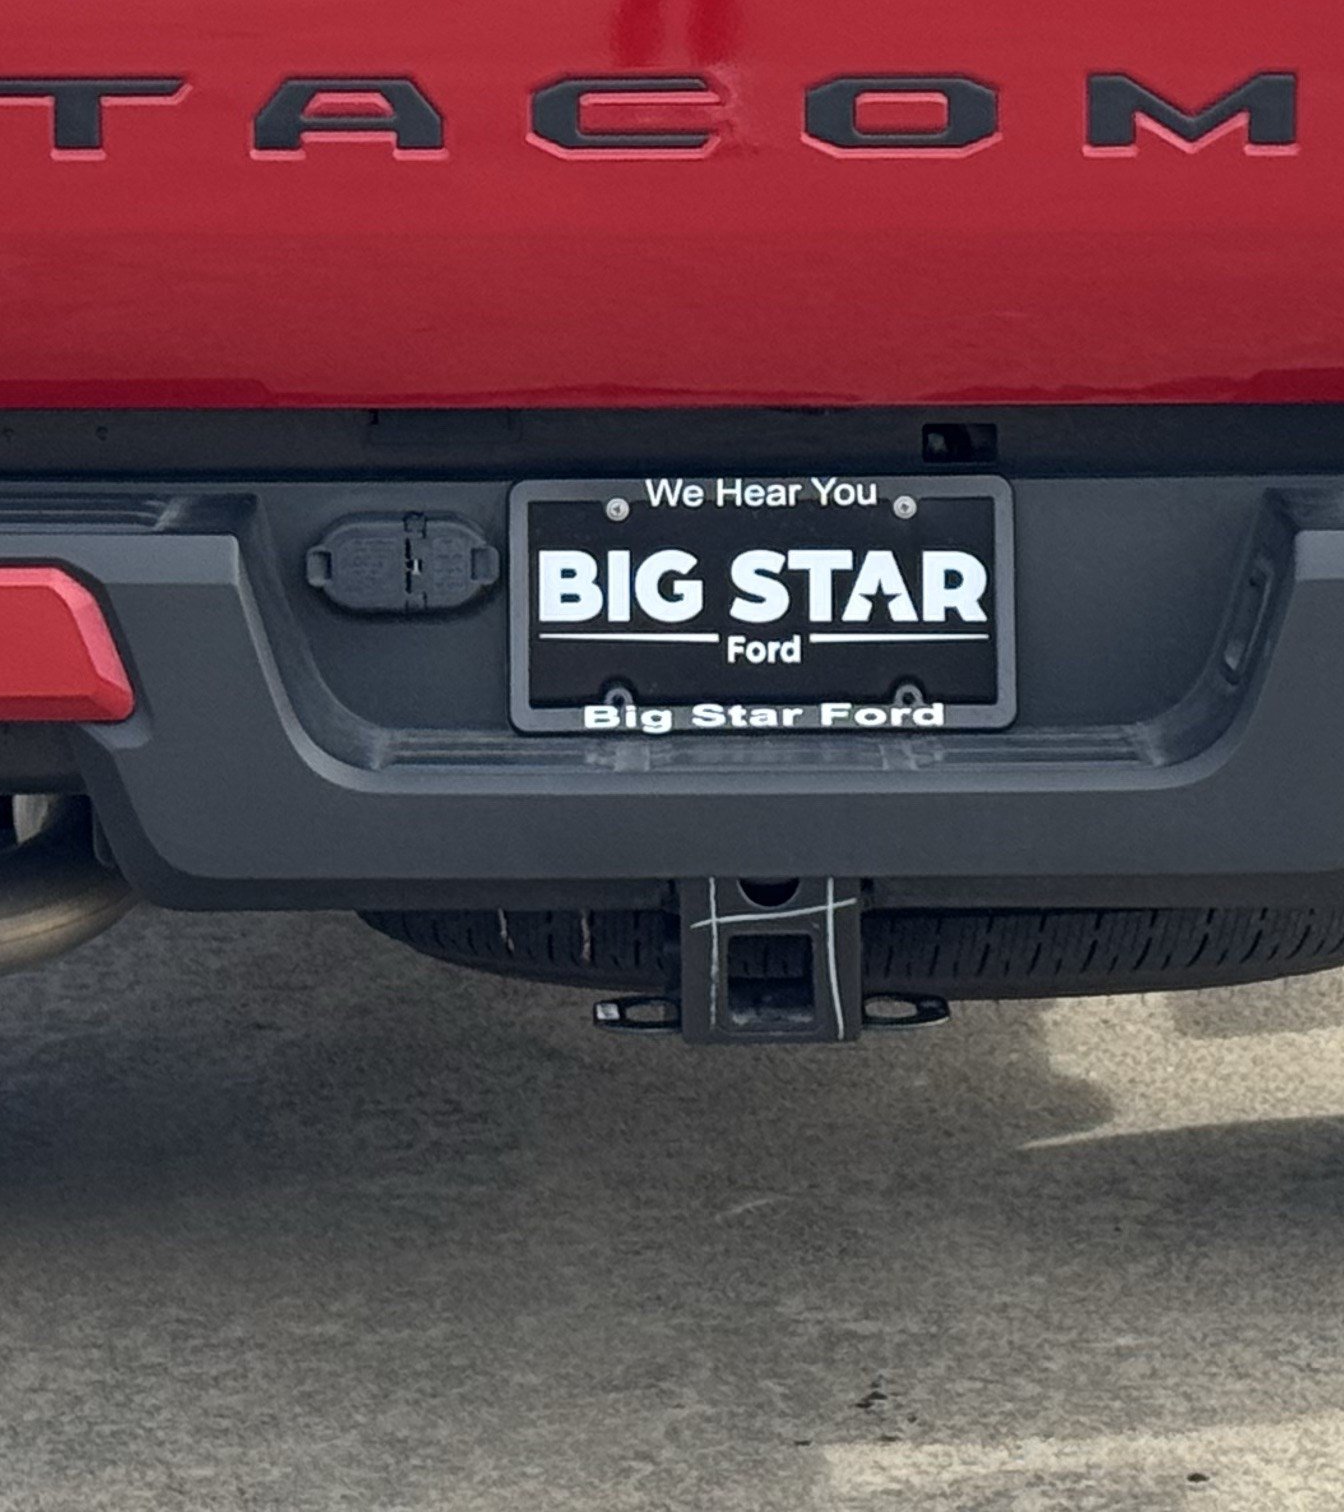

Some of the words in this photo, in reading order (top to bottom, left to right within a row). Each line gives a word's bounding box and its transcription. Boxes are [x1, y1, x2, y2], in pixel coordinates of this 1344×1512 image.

[645, 478, 704, 508] We
[716, 478, 802, 508] Hear
[811, 477, 878, 507] You
[538, 549, 704, 624] BIG
[729, 549, 988, 623] STAR
[727, 635, 802, 665] Ford
[584, 704, 673, 734] Big
[691, 703, 803, 728] Star
[819, 702, 945, 728] Ford
